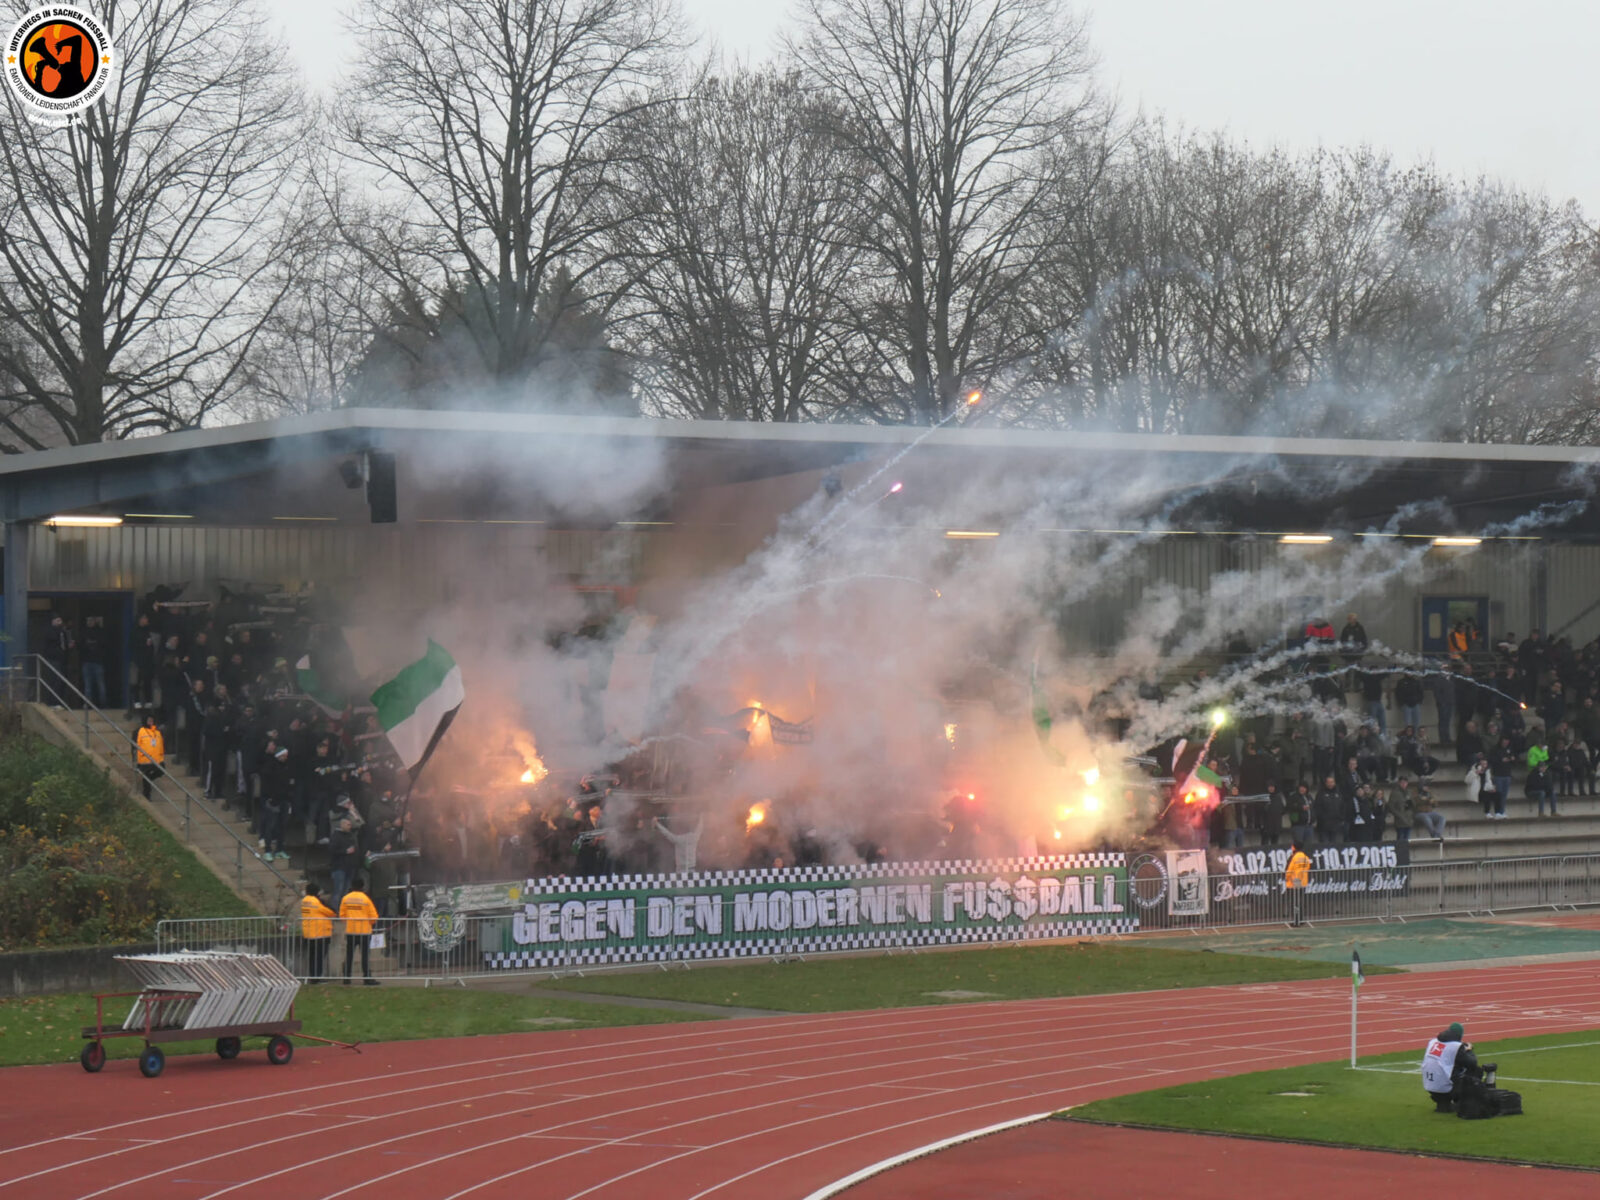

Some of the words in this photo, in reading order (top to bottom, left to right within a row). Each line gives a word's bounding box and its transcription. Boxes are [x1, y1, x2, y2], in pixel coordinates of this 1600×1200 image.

[512, 898, 636, 946] GEGEN
[647, 894, 723, 938] DEN
[733, 883, 933, 933] MODERNEN
